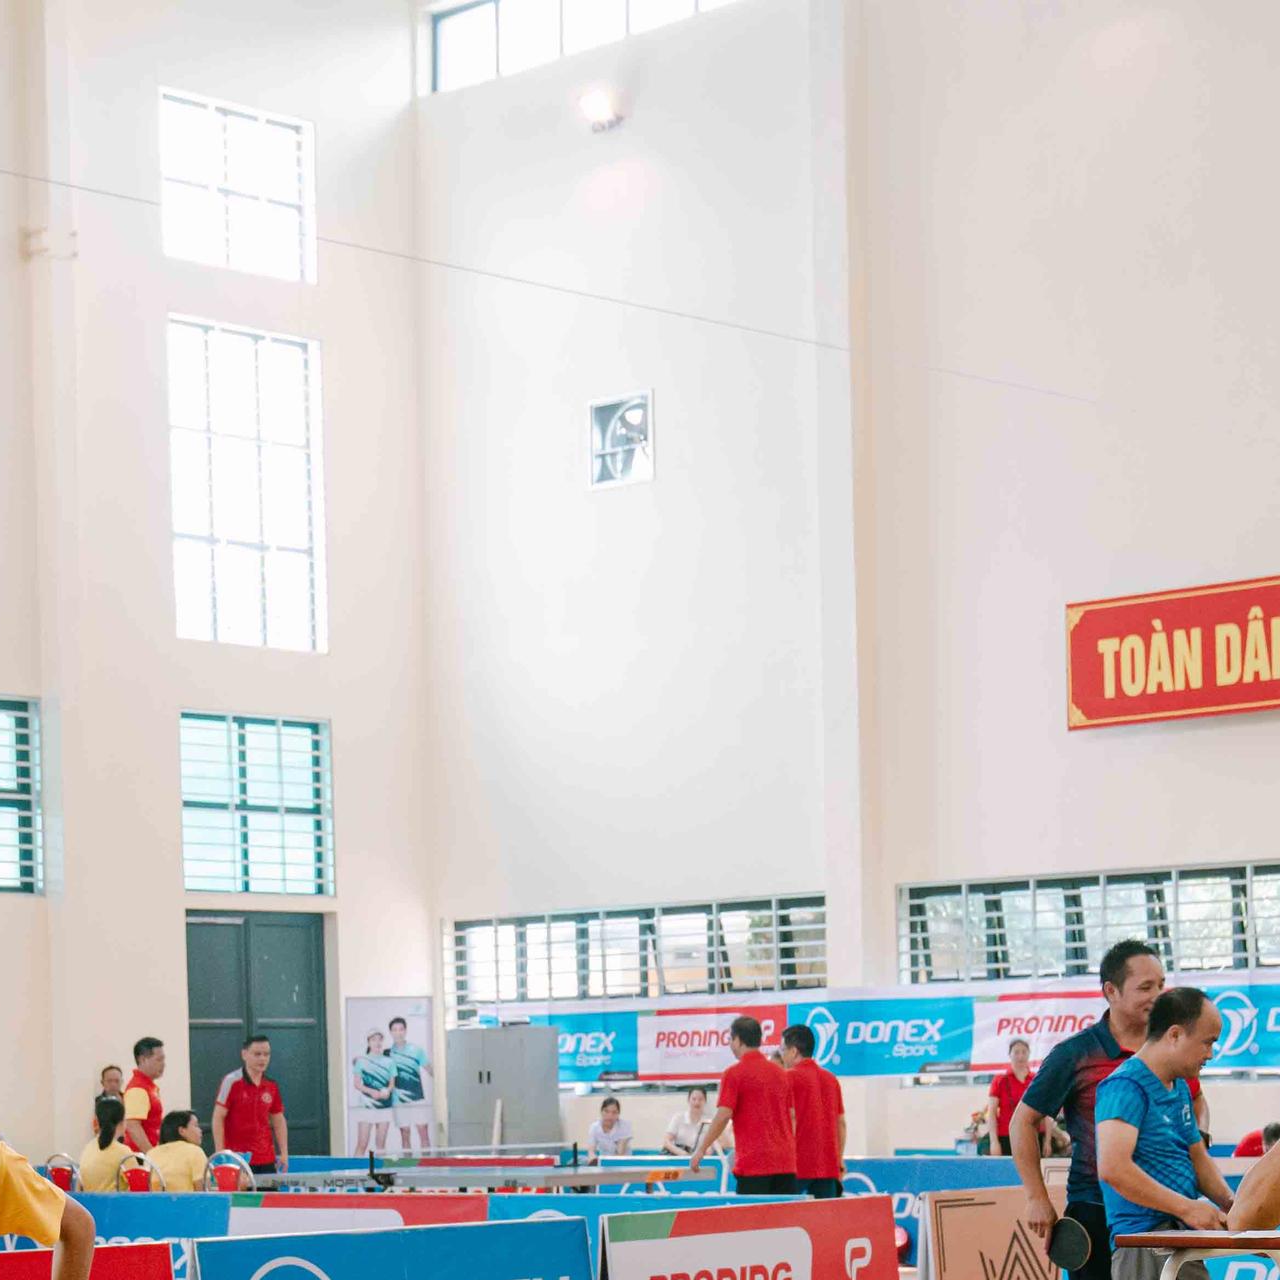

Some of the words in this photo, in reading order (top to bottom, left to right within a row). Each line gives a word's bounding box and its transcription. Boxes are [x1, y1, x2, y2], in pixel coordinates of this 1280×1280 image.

[1097, 618, 1203, 699] TOÀN
[558, 1030, 617, 1055] ONEX
[845, 1017, 945, 1045] DONEX
[892, 1042, 938, 1058] Sport
